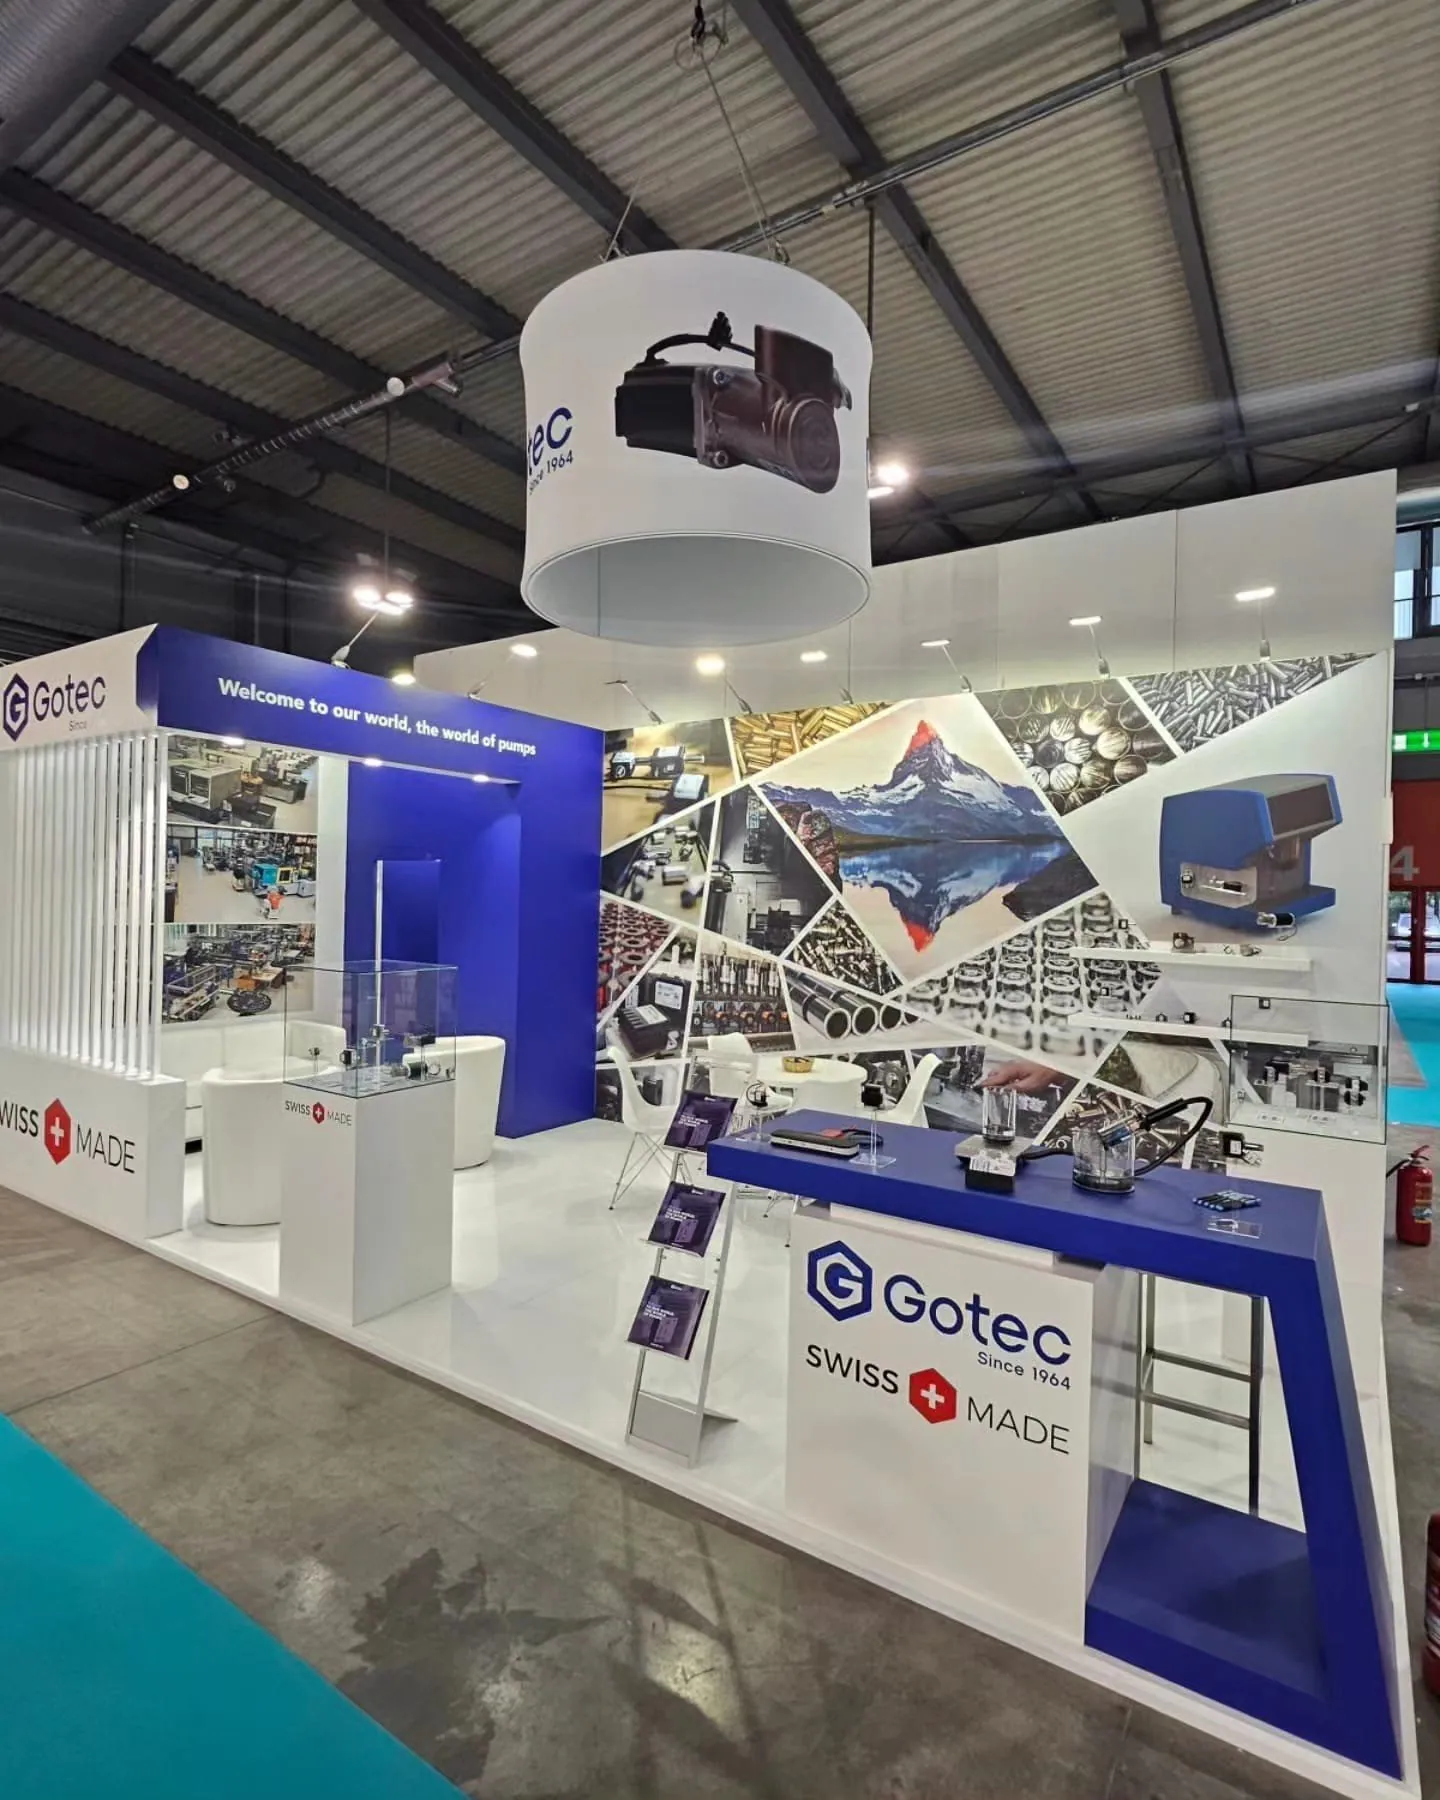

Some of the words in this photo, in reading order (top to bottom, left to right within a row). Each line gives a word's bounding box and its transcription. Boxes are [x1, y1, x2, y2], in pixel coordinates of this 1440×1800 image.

[547, 449, 574, 474] 1964
[33, 673, 106, 722] Gotec
[218, 677, 305, 710] Welcome
[309, 698, 329, 715] to
[332, 706, 361, 721] our
[364, 712, 412, 734] world,
[416, 720, 440, 738] the
[442, 728, 480, 745] world
[482, 734, 497, 748] of
[498, 739, 537, 757] pumps
[1390, 846, 1420, 881] 4
[284, 1100, 311, 1116] SWISS
[327, 1111, 352, 1126] MADE
[76, 1123, 136, 1174] MADE
[884, 1274, 1072, 1366] Gotec
[977, 1351, 1025, 1376] Since
[1032, 1367, 1071, 1391] 1964
[806, 1344, 899, 1394] SWISS
[967, 1396, 1070, 1455] MADE
